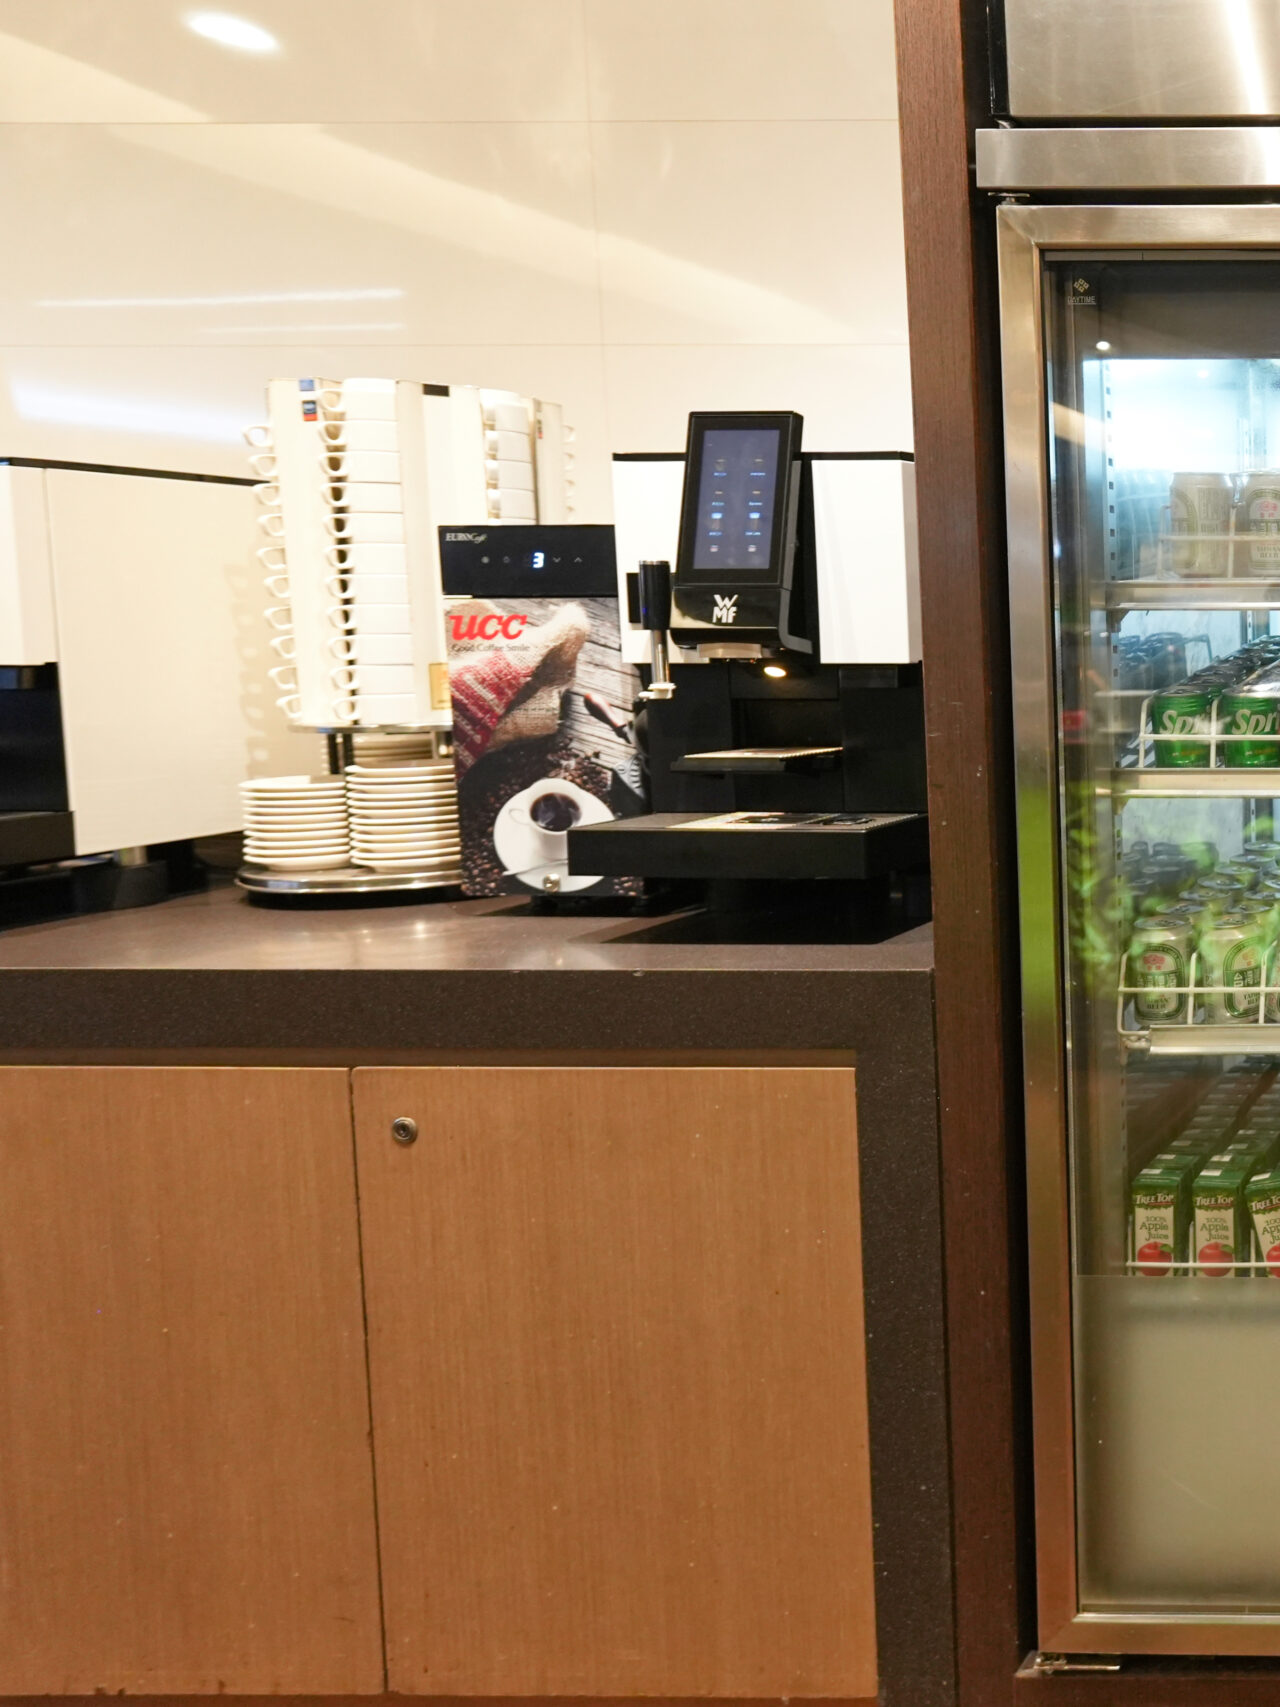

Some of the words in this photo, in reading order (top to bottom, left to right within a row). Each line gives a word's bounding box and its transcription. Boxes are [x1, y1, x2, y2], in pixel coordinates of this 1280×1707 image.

[533, 552, 544, 568] 3
[506, 643, 531, 652] Smile
[1136, 1194, 1156, 1204] TREE
[1157, 1193, 1174, 1203] TOP
[1196, 1196, 1216, 1206] TREE
[1216, 1194, 1233, 1204] TOP
[1251, 1199, 1271, 1212] TREE
[1139, 1222, 1168, 1232] Apple
[1200, 1223, 1229, 1233] Apple
[1145, 1231, 1169, 1241] Juice
[1206, 1232, 1229, 1242] Juice
